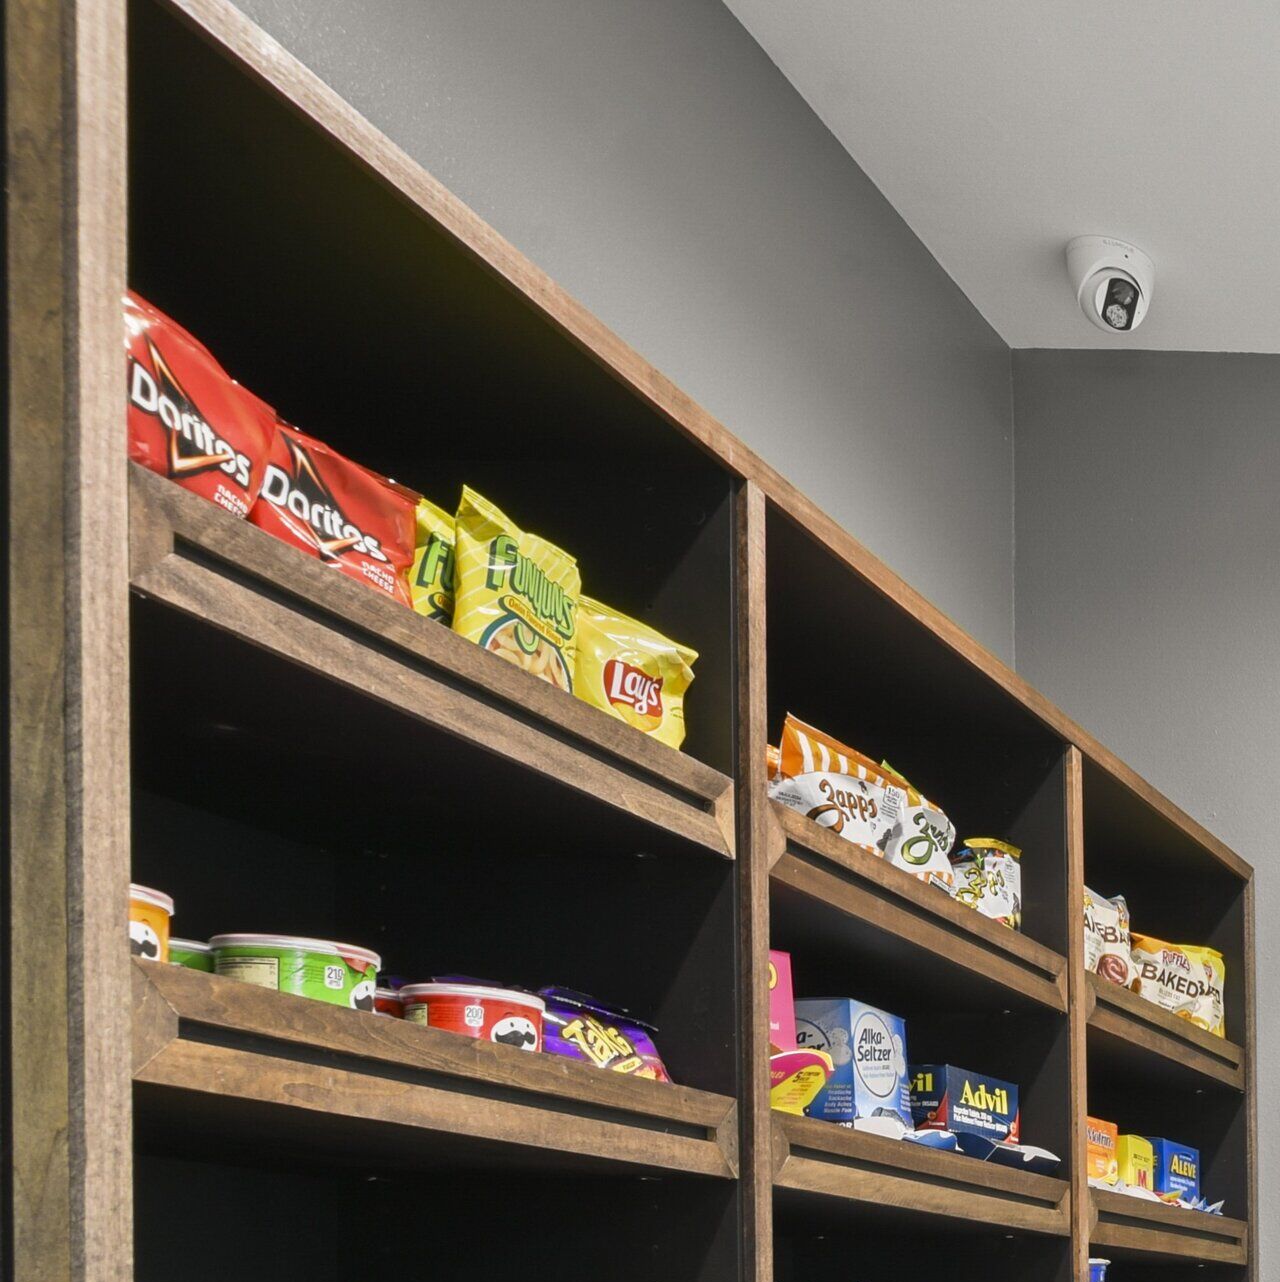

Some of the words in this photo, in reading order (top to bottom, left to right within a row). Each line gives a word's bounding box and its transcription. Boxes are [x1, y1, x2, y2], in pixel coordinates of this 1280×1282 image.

[131, 362, 251, 487] Doritos
[261, 464, 388, 562] Doritos
[362, 568, 394, 594] CHEESE
[610, 661, 660, 715] Lay's
[1162, 949, 1191, 972] RUFFLES
[1141, 962, 1199, 999] BAKED
[456, 1006, 475, 1021] 200
[859, 1027, 885, 1046] Alka-
[857, 1045, 892, 1062] Seltzer
[909, 1072, 934, 1093] vil
[960, 1079, 1009, 1115] Advil
[1170, 1154, 1197, 1179] ALEVE
